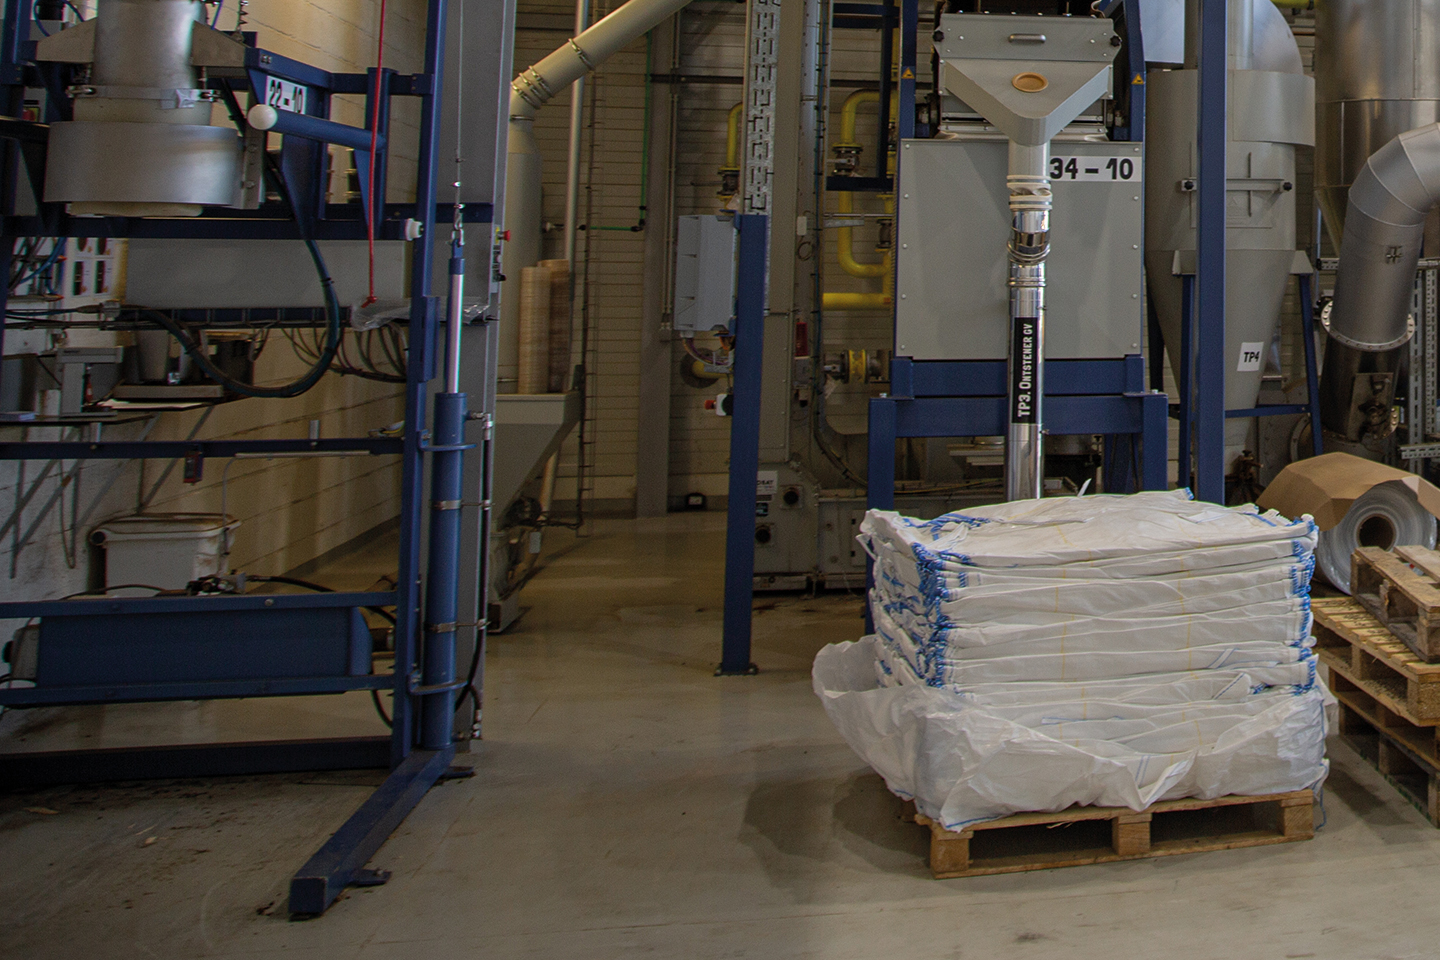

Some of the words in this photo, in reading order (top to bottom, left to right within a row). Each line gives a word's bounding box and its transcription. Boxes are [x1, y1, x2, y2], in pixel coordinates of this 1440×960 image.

[269, 79, 283, 109] 22
[292, 86, 304, 114] 10
[1050, 157, 1078, 180] 34
[1105, 157, 1134, 180] 10
[1022, 323, 1034, 335] GV
[1243, 351, 1260, 363] TP4
[1017, 391, 1032, 418] TP3.
